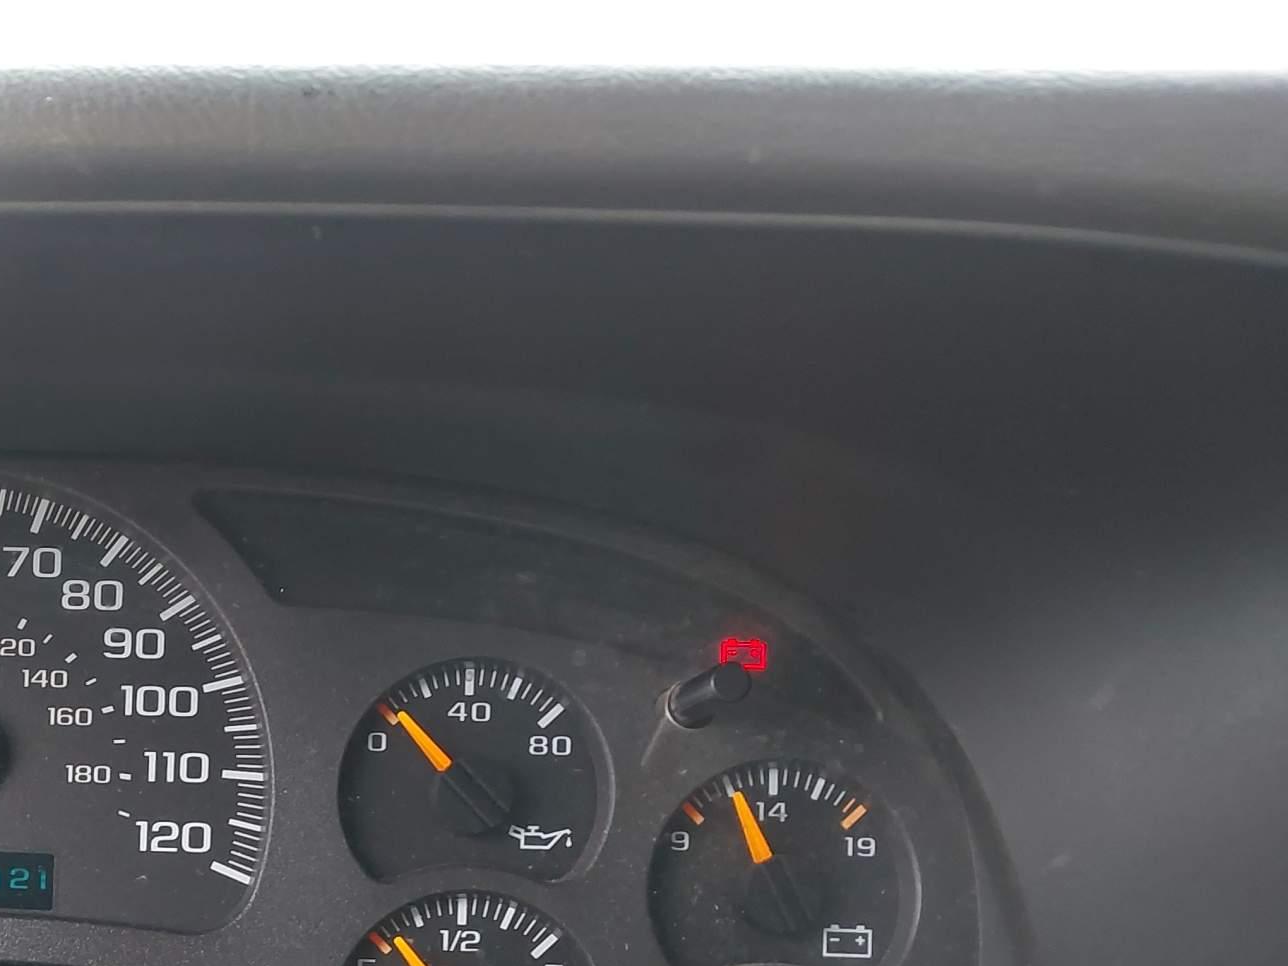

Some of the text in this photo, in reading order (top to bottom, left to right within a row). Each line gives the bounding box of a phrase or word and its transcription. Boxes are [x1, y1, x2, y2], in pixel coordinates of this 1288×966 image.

[3, 547, 63, 577] 70
[61, 580, 123, 610] 80
[102, 629, 165, 659] 90
[22, 669, 67, 688] 140
[120, 685, 199, 717] 100
[47, 707, 93, 726] 160
[447, 702, 492, 722] 40
[367, 732, 387, 753] 0
[528, 736, 572, 756] 80
[66, 765, 111, 784] 180
[143, 752, 209, 783] 110
[756, 802, 788, 823] 14
[136, 821, 212, 853] 120
[670, 831, 689, 852] 9
[844, 837, 876, 858] 19
[440, 930, 481, 952] 1/2
